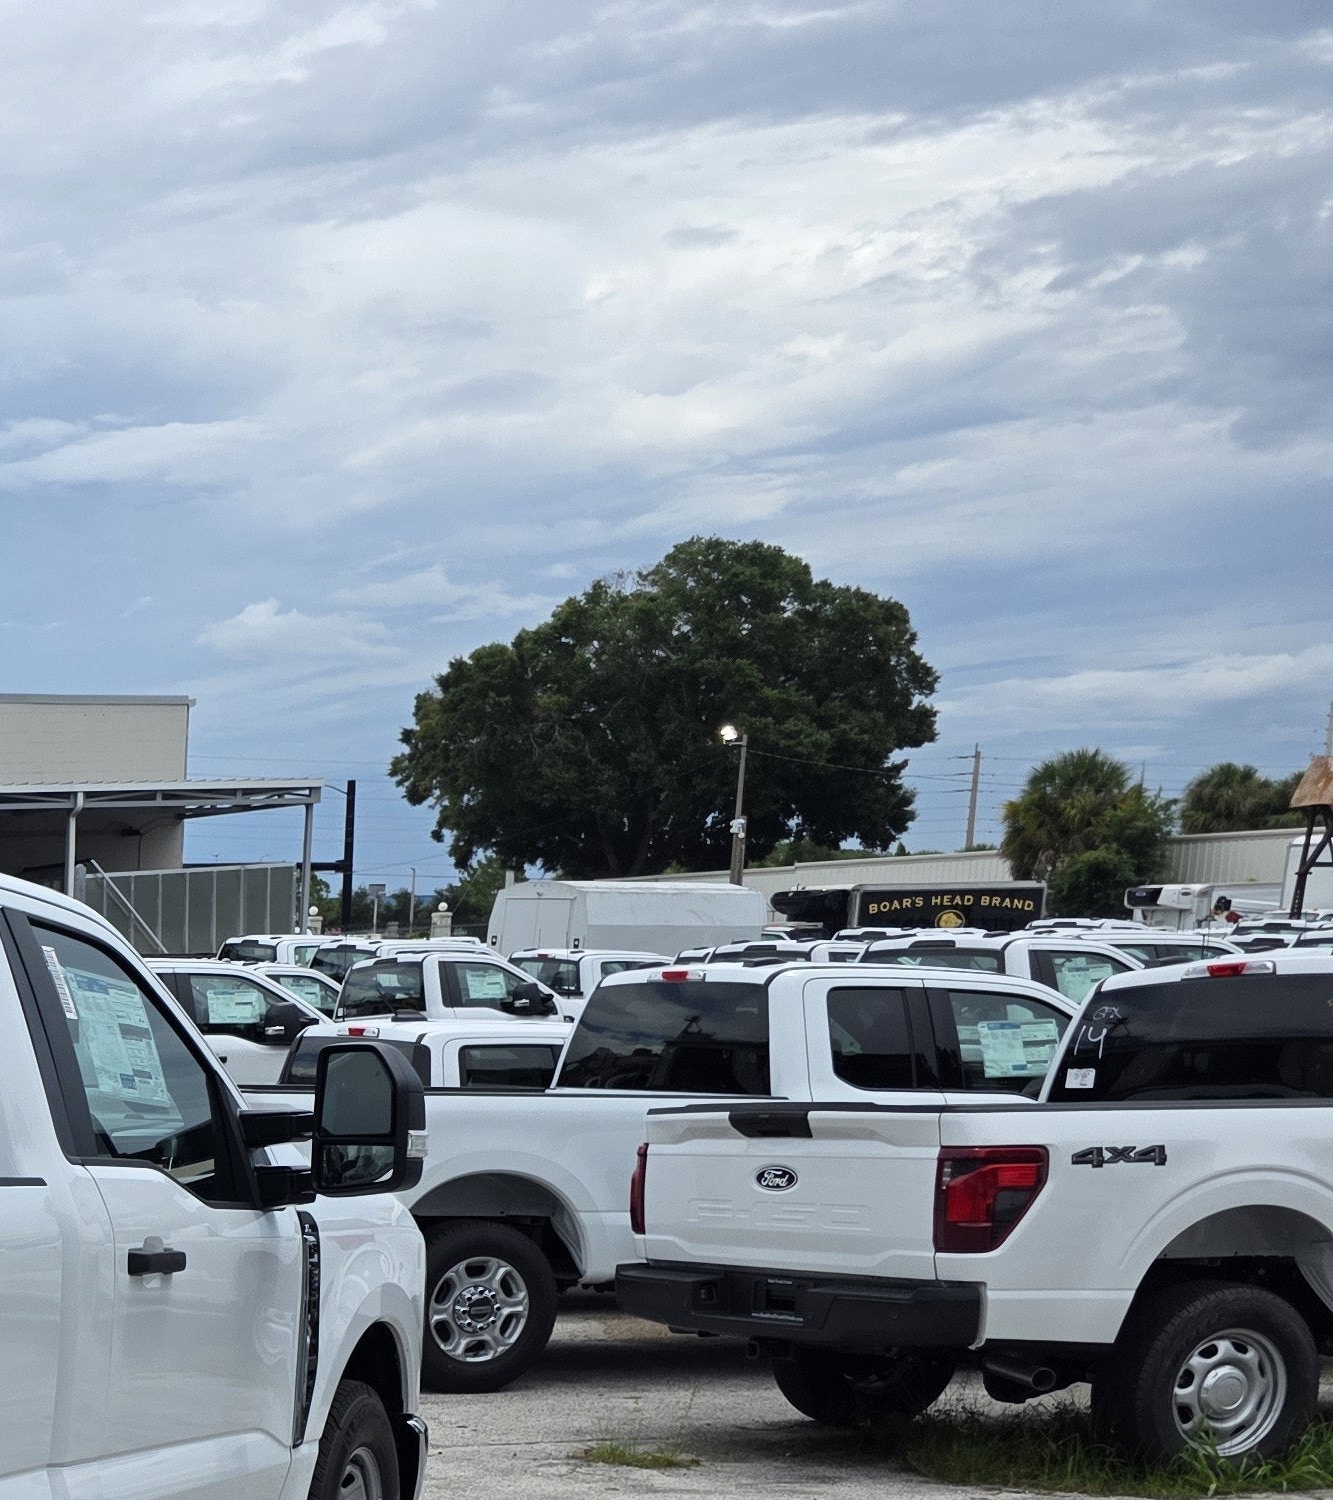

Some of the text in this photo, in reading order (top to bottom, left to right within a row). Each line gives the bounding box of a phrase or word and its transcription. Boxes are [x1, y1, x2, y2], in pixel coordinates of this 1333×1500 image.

[868, 895, 1034, 915] BOAR'S HEAD BRAND
[1074, 1025, 1107, 1059] 14
[761, 1169, 788, 1187] Ford
